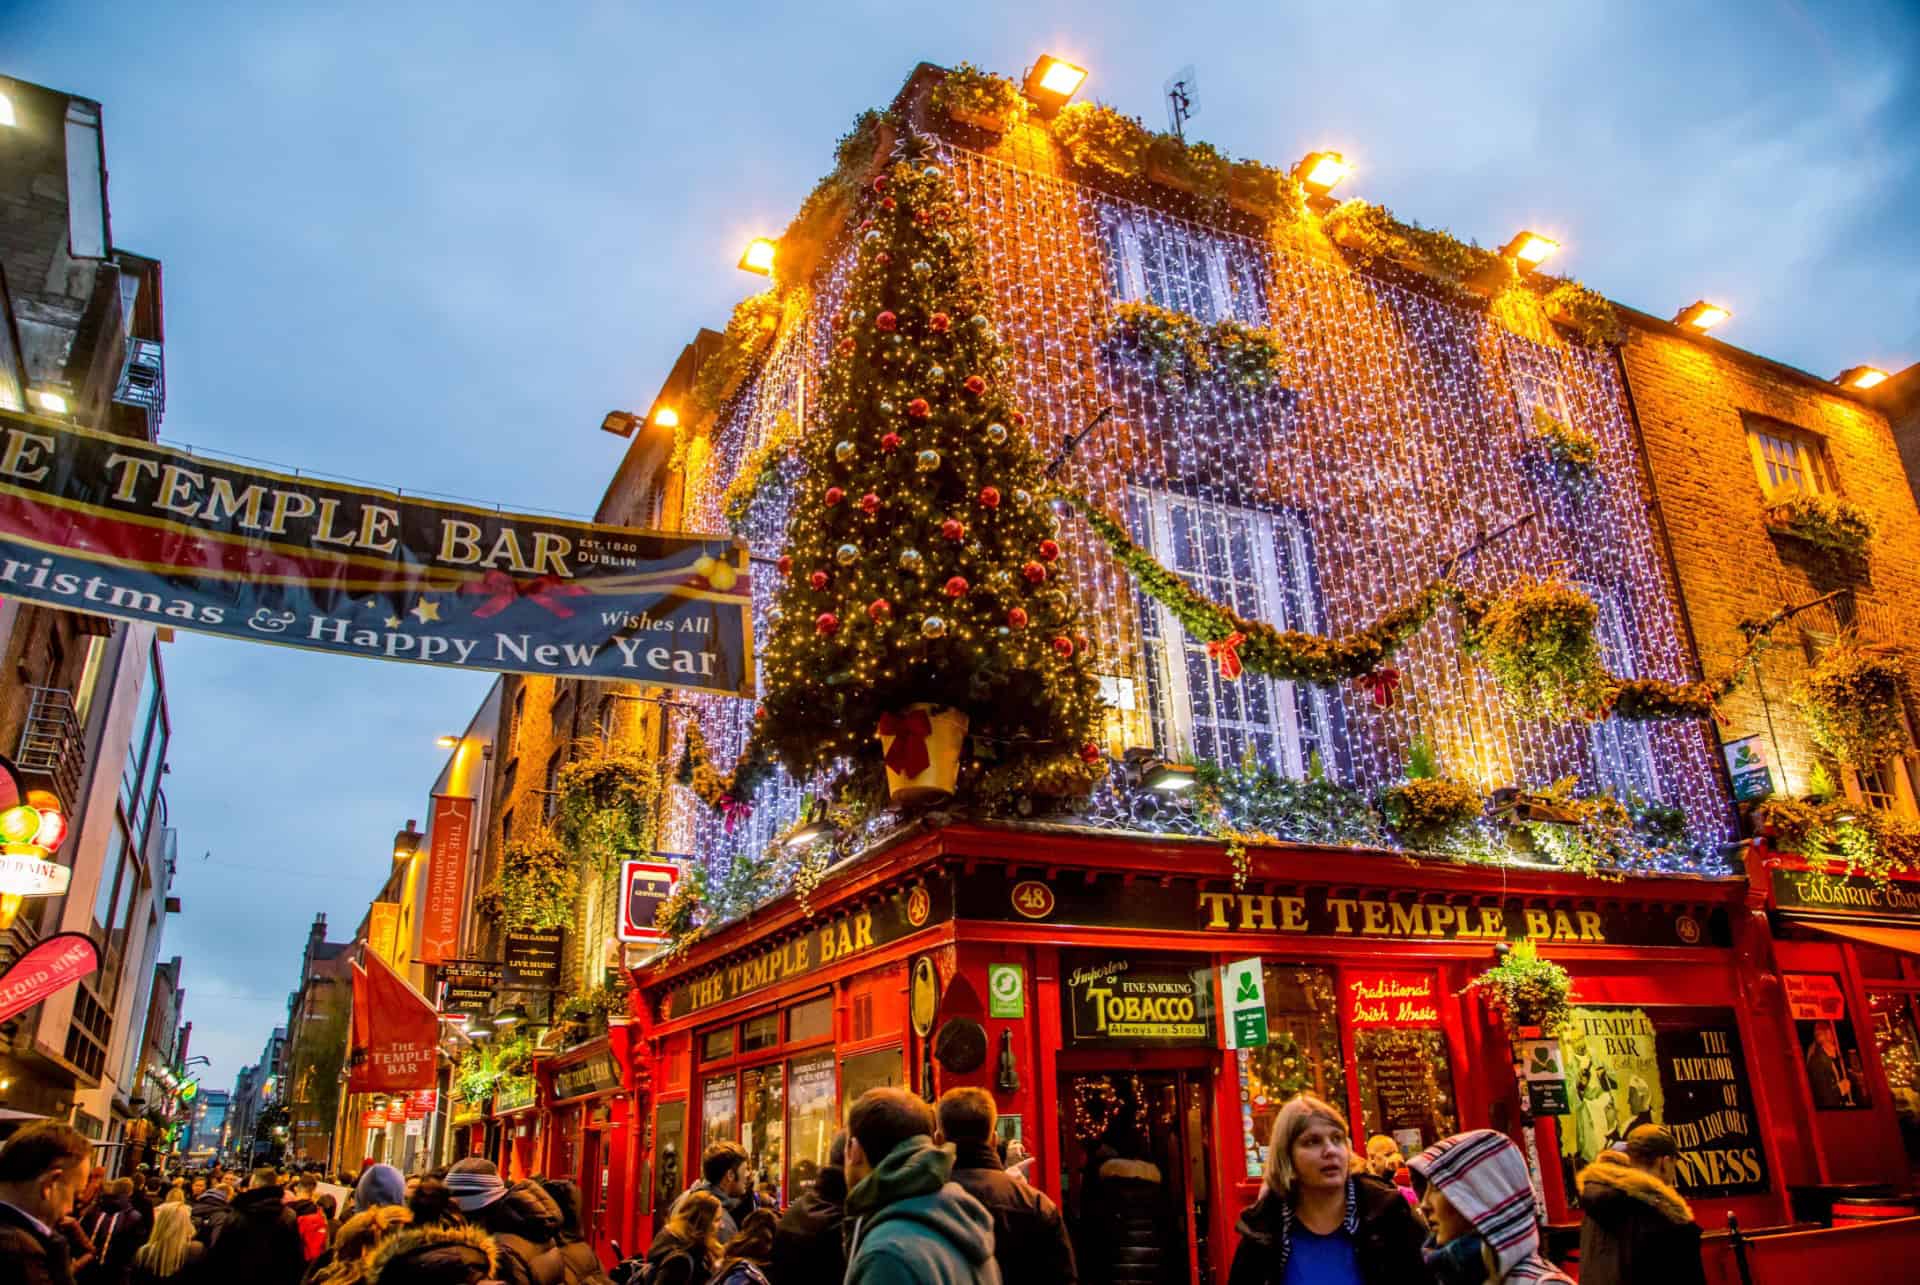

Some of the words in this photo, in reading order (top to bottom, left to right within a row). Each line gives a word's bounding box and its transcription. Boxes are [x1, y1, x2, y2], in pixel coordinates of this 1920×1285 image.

[0, 428, 55, 483] E
[105, 453, 399, 554] TEMPLE
[436, 519, 573, 578] BAR
[578, 551, 637, 567] DUBLIN
[0, 558, 224, 624] ristmas
[248, 607, 296, 632] &
[307, 615, 479, 662] Happy
[494, 634, 601, 667] New
[612, 635, 717, 676] Year
[600, 611, 674, 632] Wishes
[679, 616, 709, 634] All
[449, 824, 462, 849] THE
[443, 852, 458, 905] TEMPLE
[1019, 887, 1046, 910] 48
[440, 906, 455, 935] BAR
[1200, 893, 1309, 932] THE
[1327, 899, 1507, 938] TEMPLE
[1524, 909, 1605, 940] BAR
[50, 944, 89, 974] NINE
[509, 960, 528, 968] LIVE
[529, 961, 557, 969] MUSIC
[689, 972, 723, 1008] THE
[728, 938, 809, 994] TEMPLE
[820, 911, 873, 963] BAR
[446, 968, 459, 976] THE
[461, 969, 487, 977] TEMPLE
[519, 969, 544, 977] DAILY
[1068, 960, 1128, 988] Importers
[1106, 975, 1117, 984] OF
[1122, 982, 1146, 993] FINE
[1147, 983, 1192, 993] SMOKING
[1350, 977, 1431, 1000] Traditional
[1086, 988, 1194, 1031] TOBACCO
[1352, 1001, 1388, 1022] Irish
[1395, 1001, 1437, 1021] Music
[1111, 1024, 1152, 1035] Always
[1157, 1025, 1168, 1034] in
[1172, 1024, 1203, 1035] Stock
[1580, 1018, 1651, 1036] TEMPLE
[392, 1042, 415, 1052] THE
[1604, 1038, 1639, 1056] BAR
[1700, 1031, 1729, 1053] THE
[372, 1049, 431, 1065] TEMPLE
[1672, 1057, 1735, 1080] EMPEROR
[388, 1063, 417, 1075] BAR
[1723, 1084, 1737, 1106] OF
[1670, 1122, 1700, 1149] TED
[1673, 1147, 1761, 1188] NNESS
